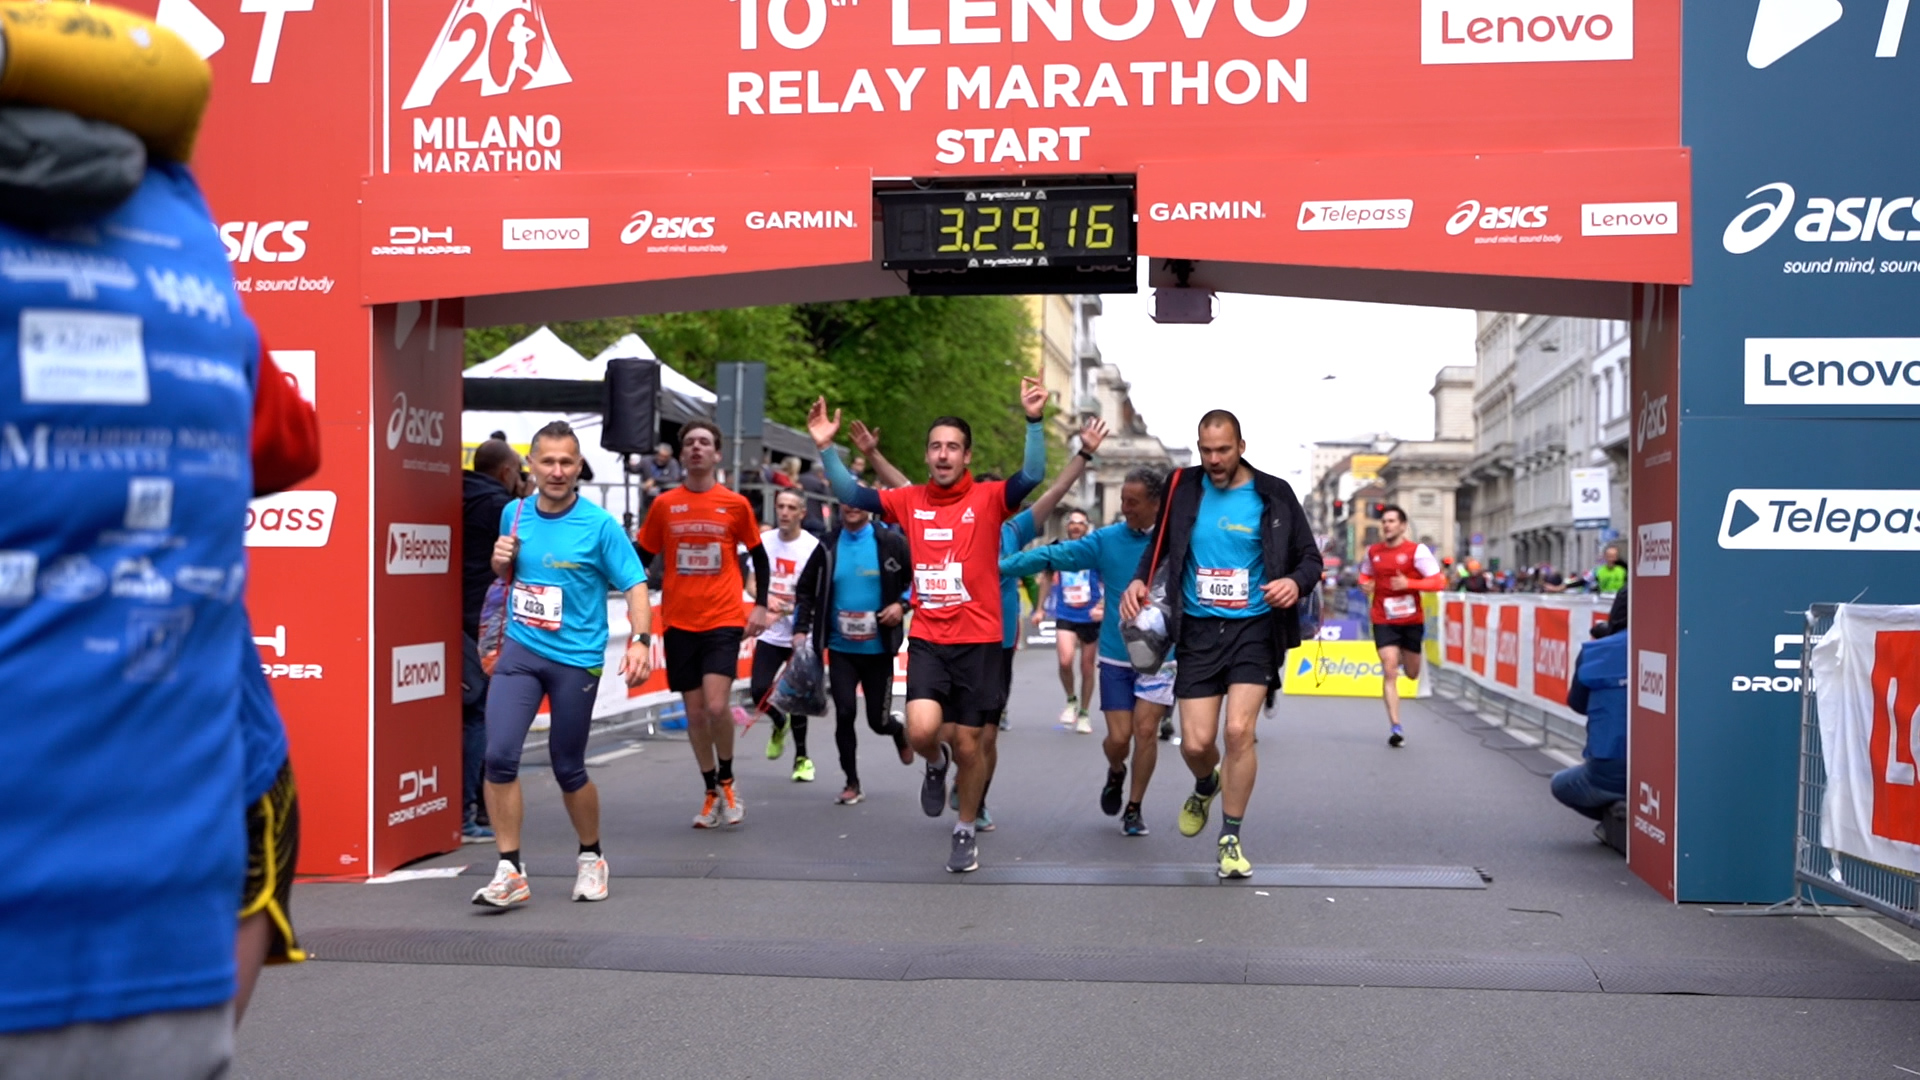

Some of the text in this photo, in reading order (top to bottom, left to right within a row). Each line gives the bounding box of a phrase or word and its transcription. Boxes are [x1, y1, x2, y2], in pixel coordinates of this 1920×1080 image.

[727, 0, 1307, 50] 10 LENOVO
[1440, 10, 1614, 45] Lenovo
[727, 58, 1308, 115] RELAY MARATHON
[413, 114, 562, 150] MILANO
[935, 126, 1090, 164] START
[413, 149, 562, 174] MARATHON
[938, 205, 1115, 252] 3.29.16
[1319, 204, 1408, 225] Telepass
[1591, 211, 1668, 227] Lenovo
[213, 220, 309, 263] sics
[389, 226, 453, 244] DH
[511, 226, 580, 241] Lenovo
[371, 245, 471, 256] DRONE HOPPER
[1783, 257, 1833, 274] sound
[1834, 257, 1876, 275] mind,
[255, 276, 298, 292] sound
[298, 276, 335, 294] body
[1581, 487, 1602, 504] 50
[243, 506, 325, 532] pass
[399, 530, 448, 568] Telepass
[1209, 583, 1234, 597] 403C
[261, 663, 323, 679] PPER
[397, 658, 441, 688] Lenovo
[1640, 663, 1664, 698] Lenovo
[399, 765, 437, 804] DH
[388, 796, 449, 826] DRONE HOPPER
